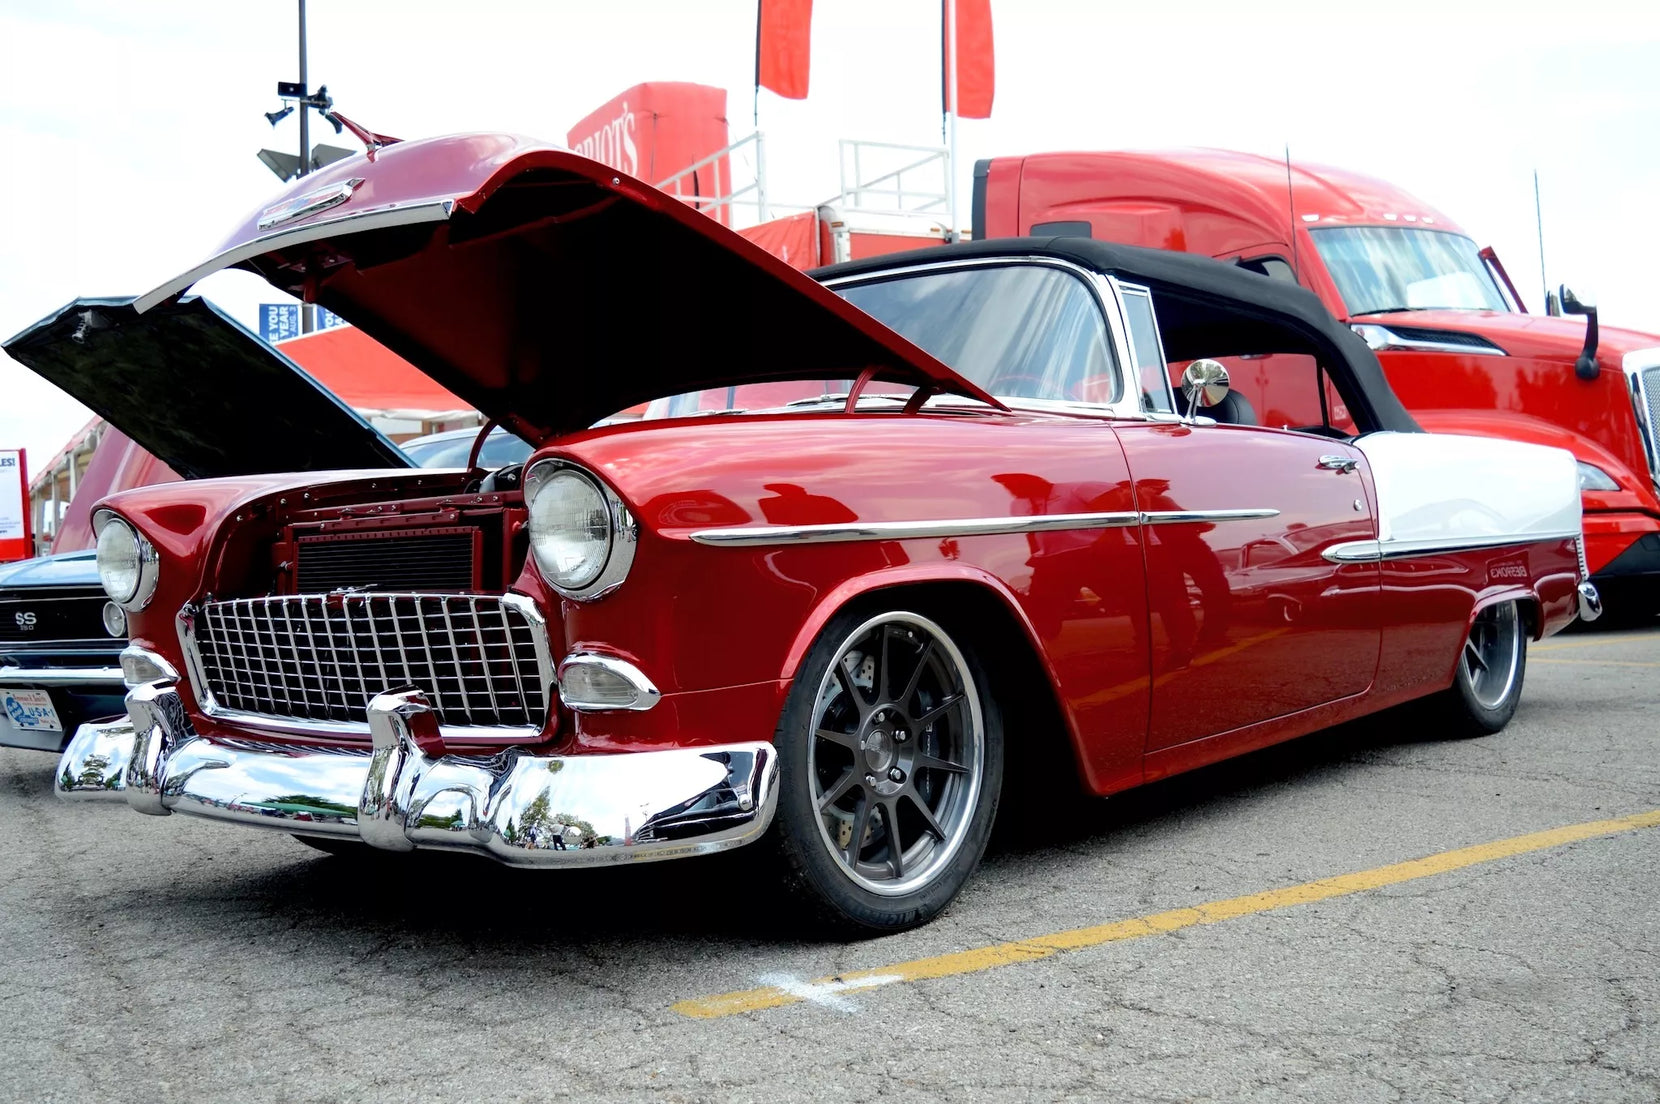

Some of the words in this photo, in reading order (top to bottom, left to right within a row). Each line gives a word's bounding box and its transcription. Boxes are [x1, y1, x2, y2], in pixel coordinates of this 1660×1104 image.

[268, 306, 279, 329] YOU
[279, 306, 289, 339] YEAR
[289, 314, 297, 332] AUG.
[15, 611, 37, 625] SS
